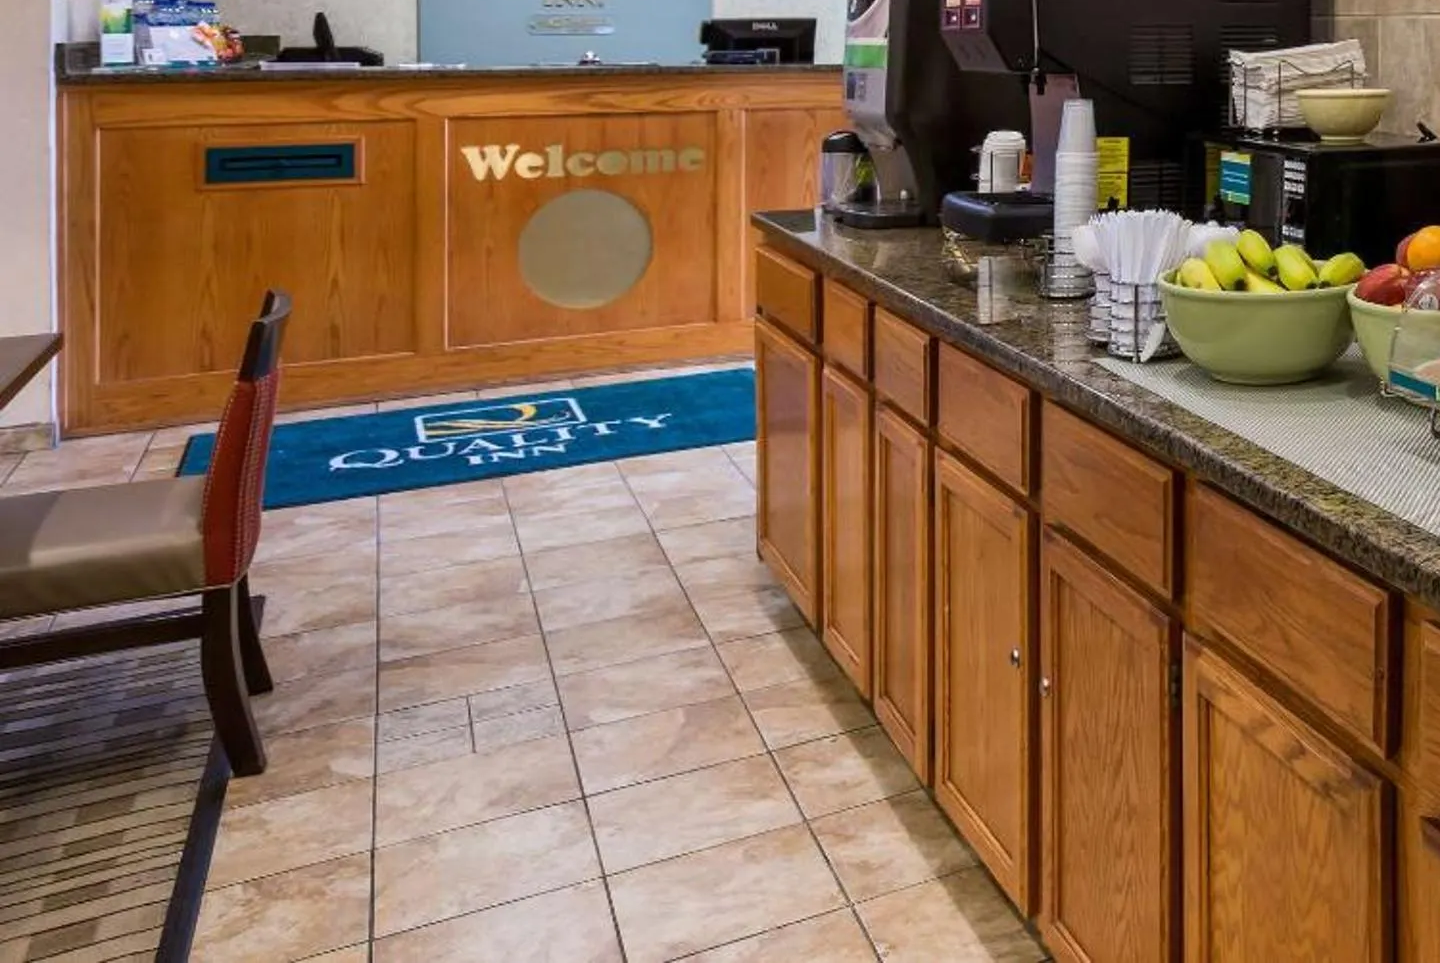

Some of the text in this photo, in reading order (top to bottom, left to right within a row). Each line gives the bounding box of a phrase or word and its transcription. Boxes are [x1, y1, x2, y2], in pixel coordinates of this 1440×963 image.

[461, 144, 704, 181] Welcome
[328, 412, 672, 471] QUALITY
[466, 442, 567, 466] INN
